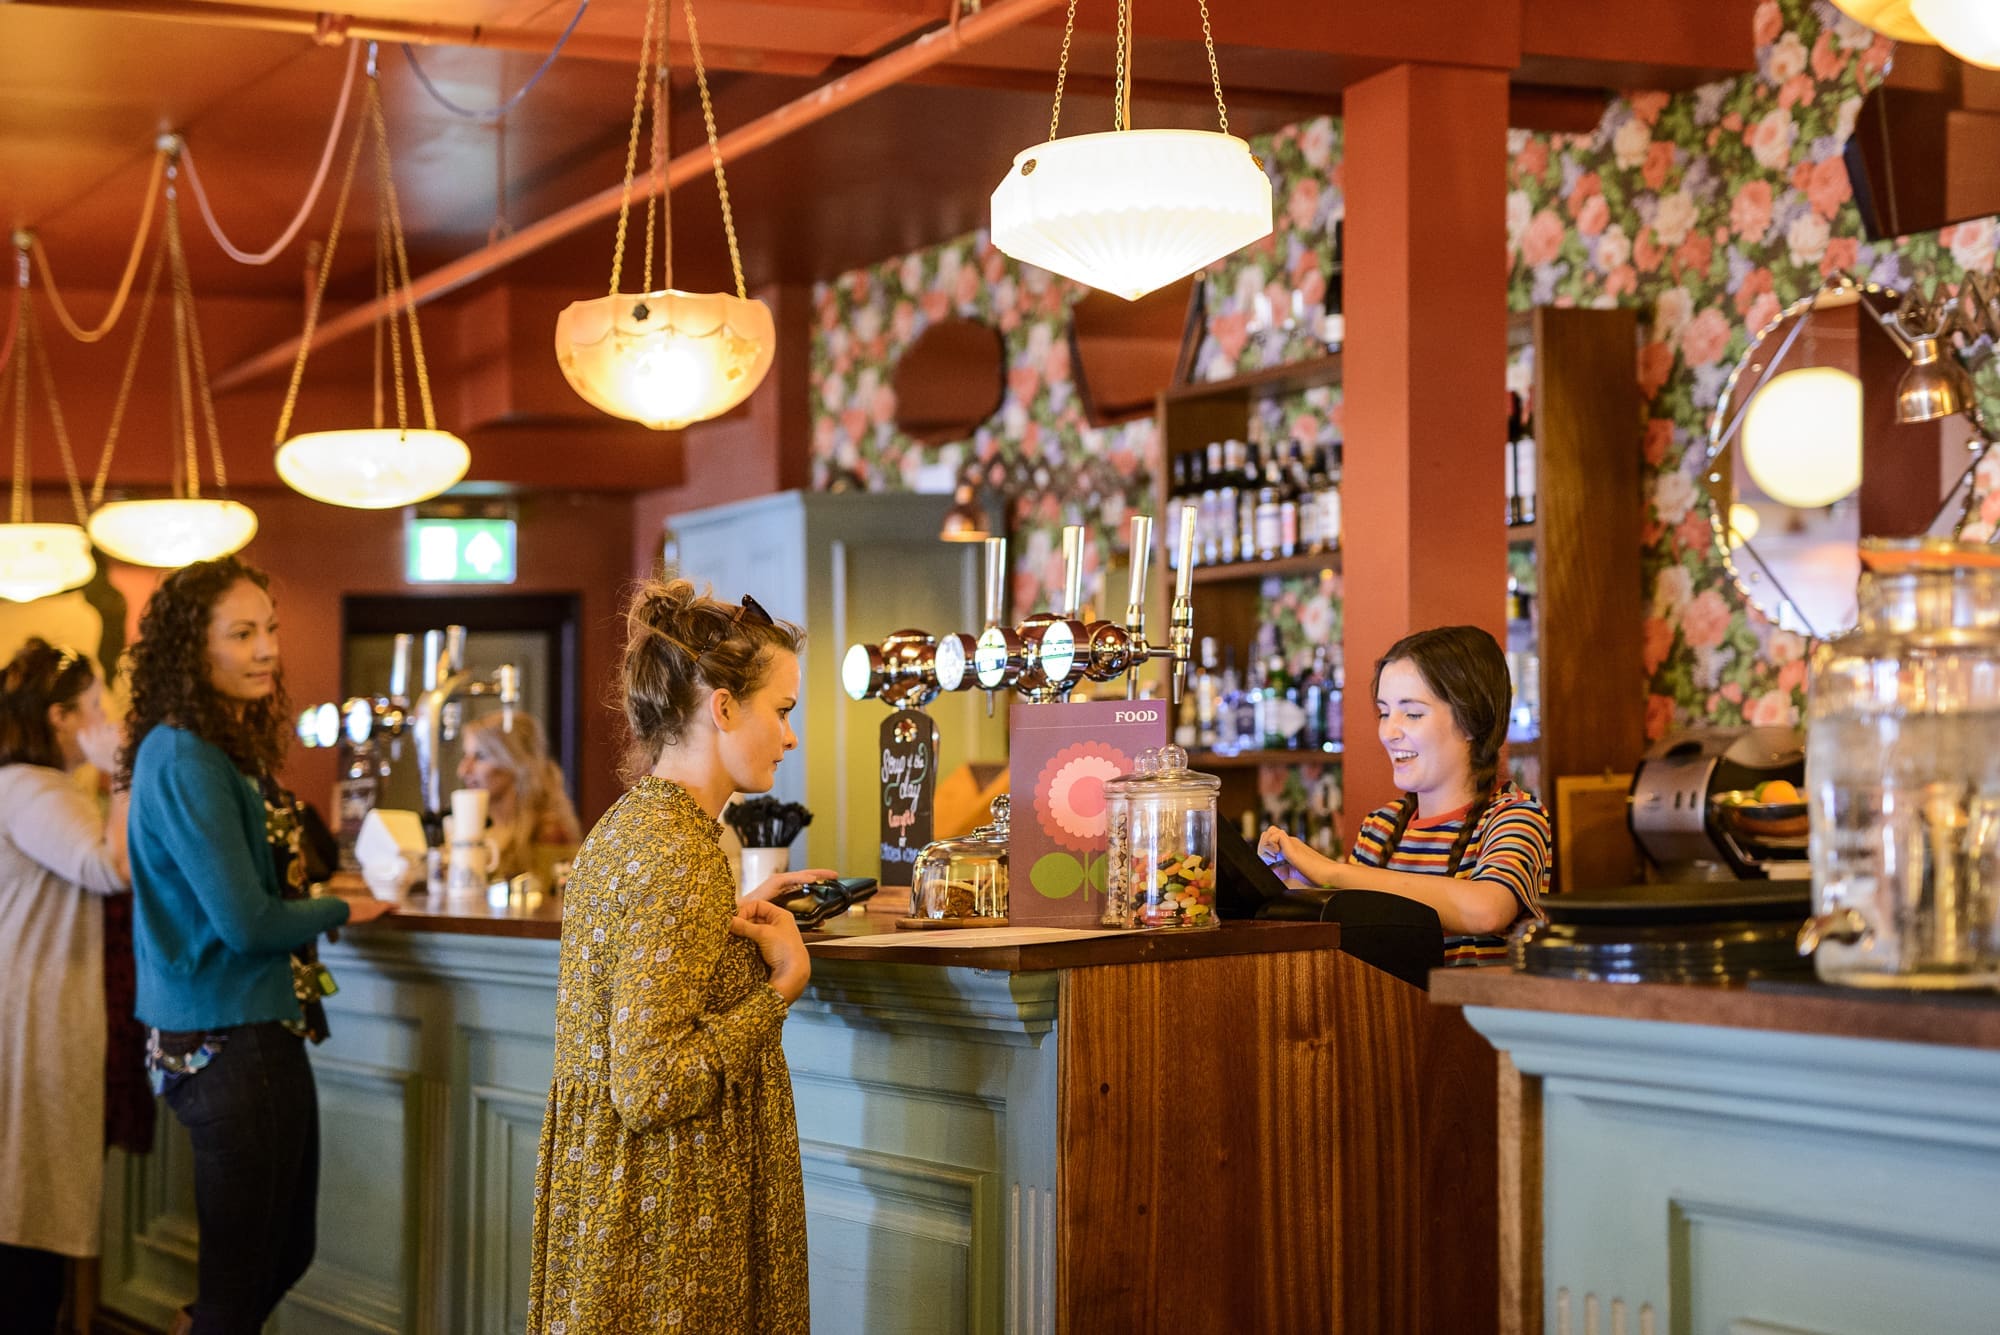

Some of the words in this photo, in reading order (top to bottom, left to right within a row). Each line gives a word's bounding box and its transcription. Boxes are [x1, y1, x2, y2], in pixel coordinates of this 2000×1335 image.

[1115, 710, 1158, 722] FOOD
[882, 749, 905, 783] Soup
[899, 768, 921, 812] day
